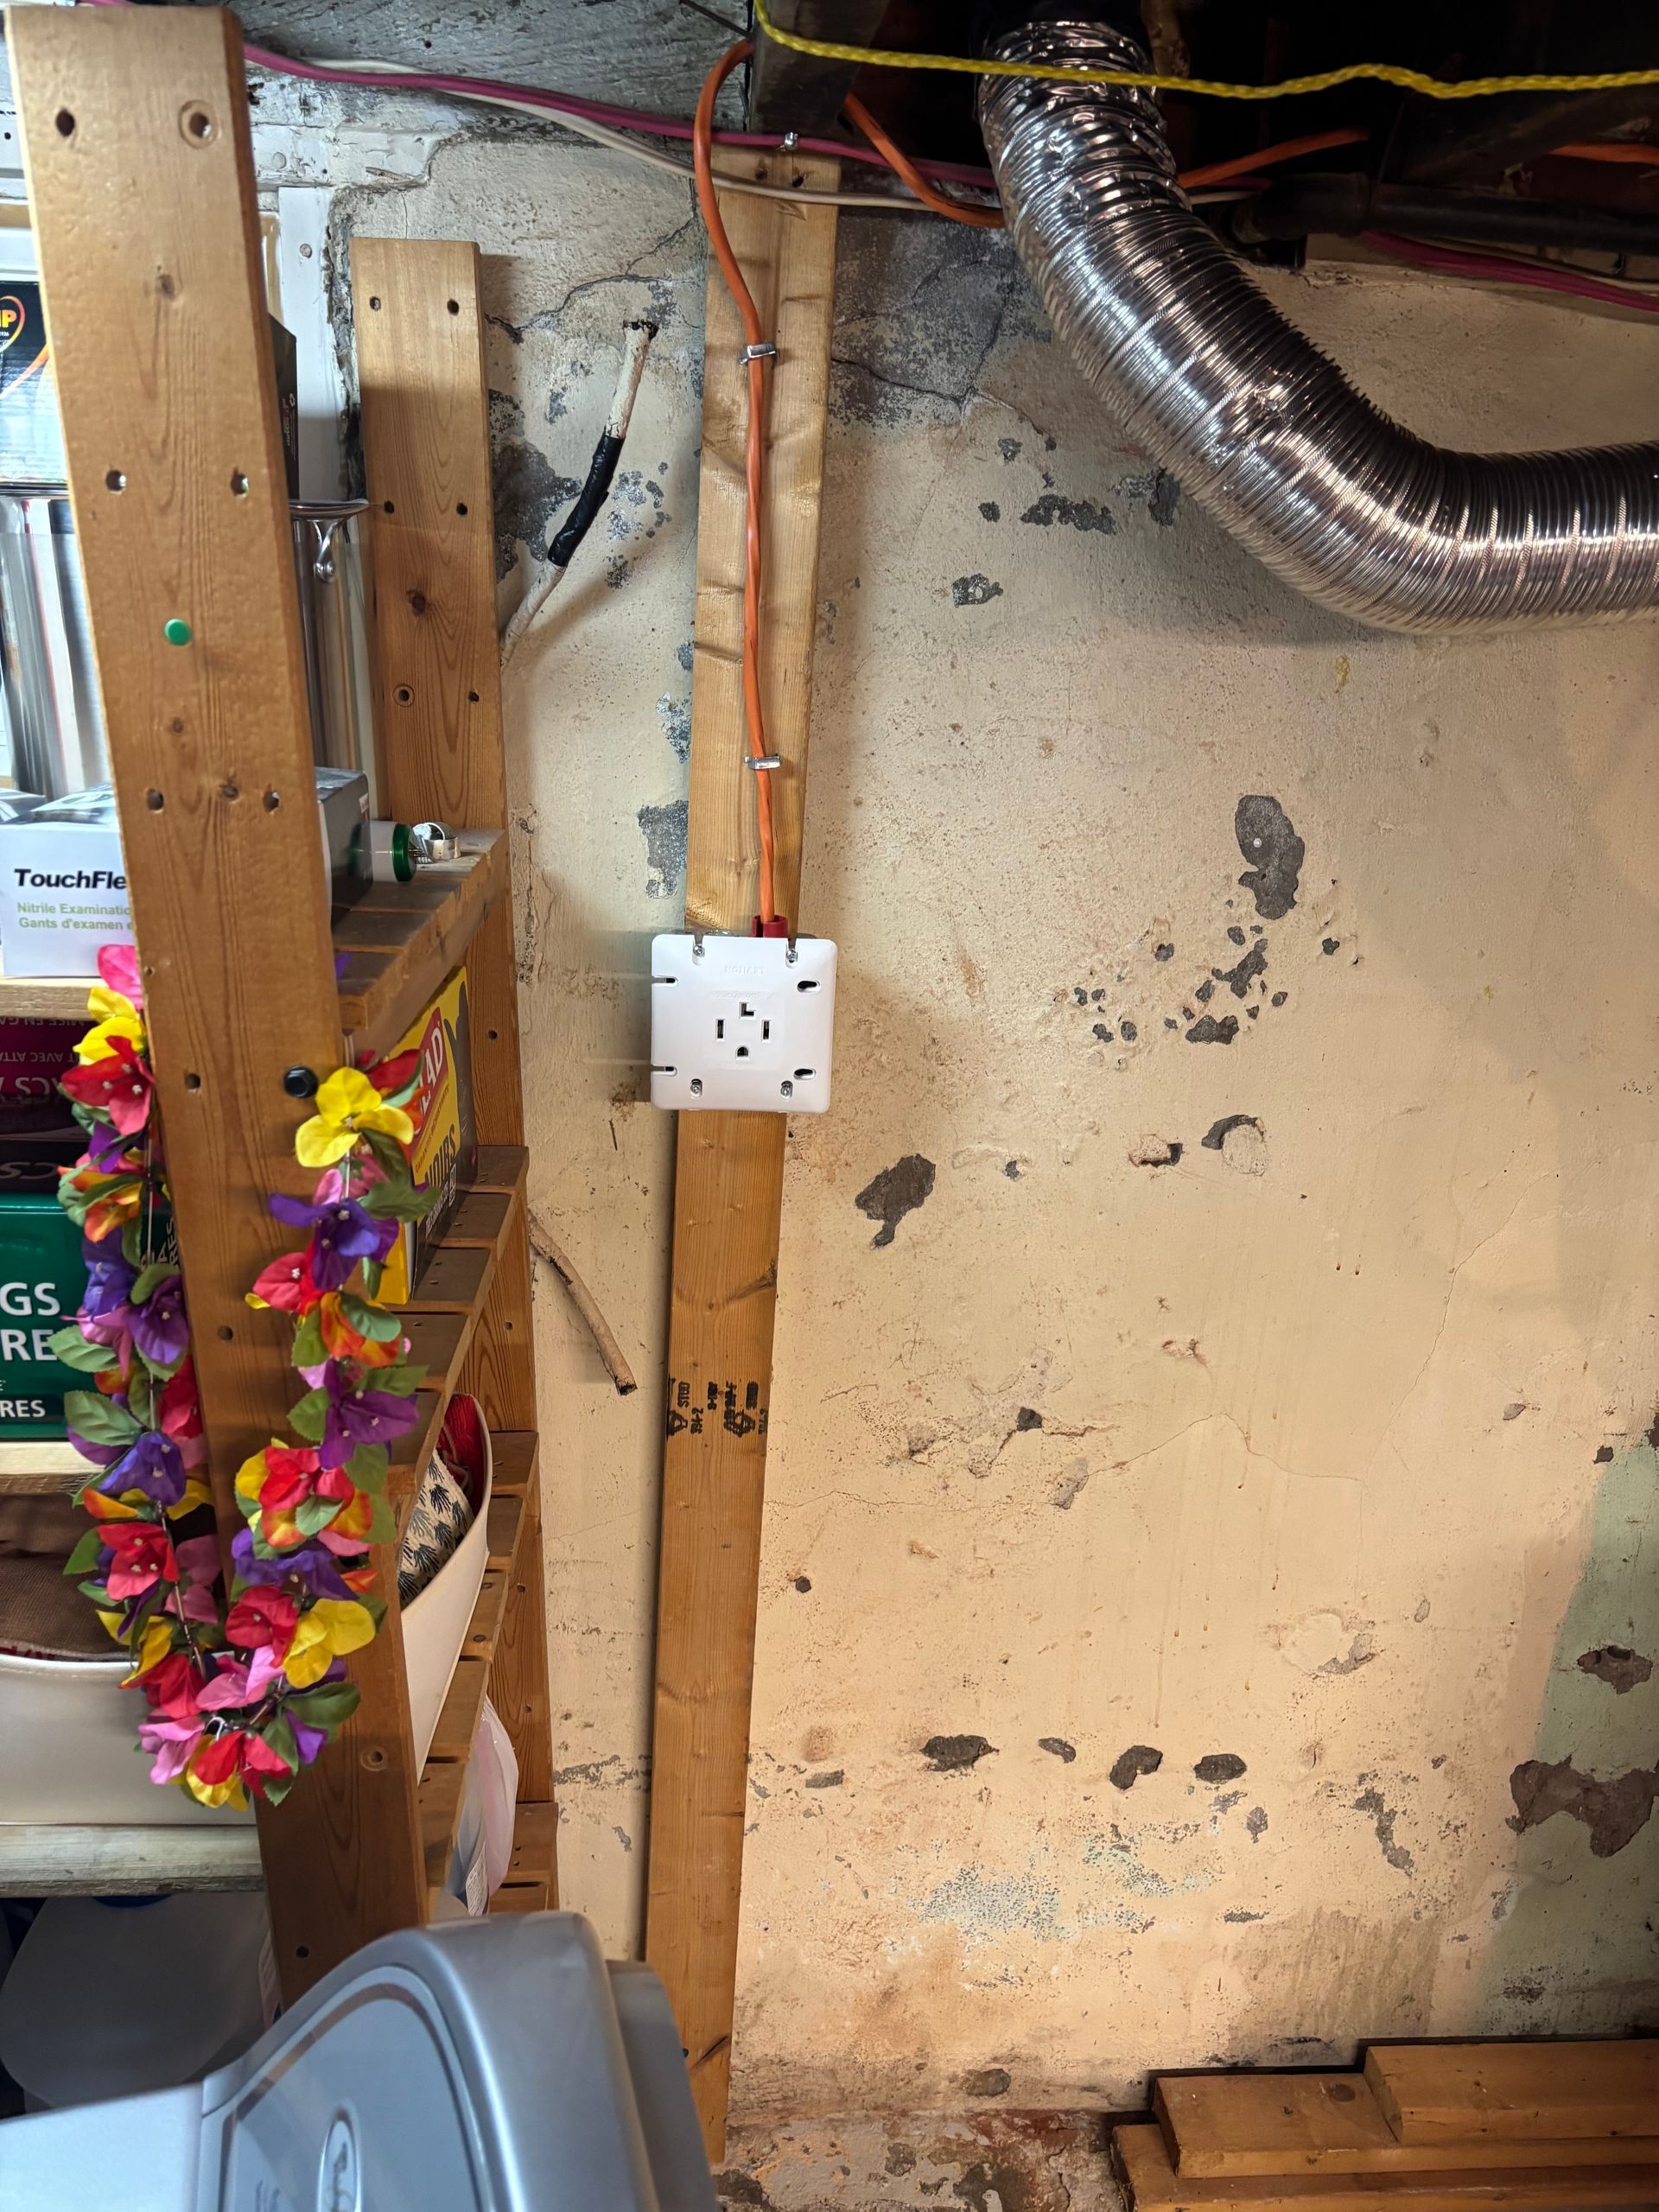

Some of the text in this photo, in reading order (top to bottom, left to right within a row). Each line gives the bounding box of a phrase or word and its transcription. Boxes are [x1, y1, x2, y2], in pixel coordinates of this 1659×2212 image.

[17, 901, 55, 914] Nitrile
[19, 917, 57, 929] Gants
[61, 918, 124, 931] d'examen
[30, 1052, 64, 1063] AVEC
[0, 1281, 61, 1317] GS
[0, 1400, 46, 1418] RES
